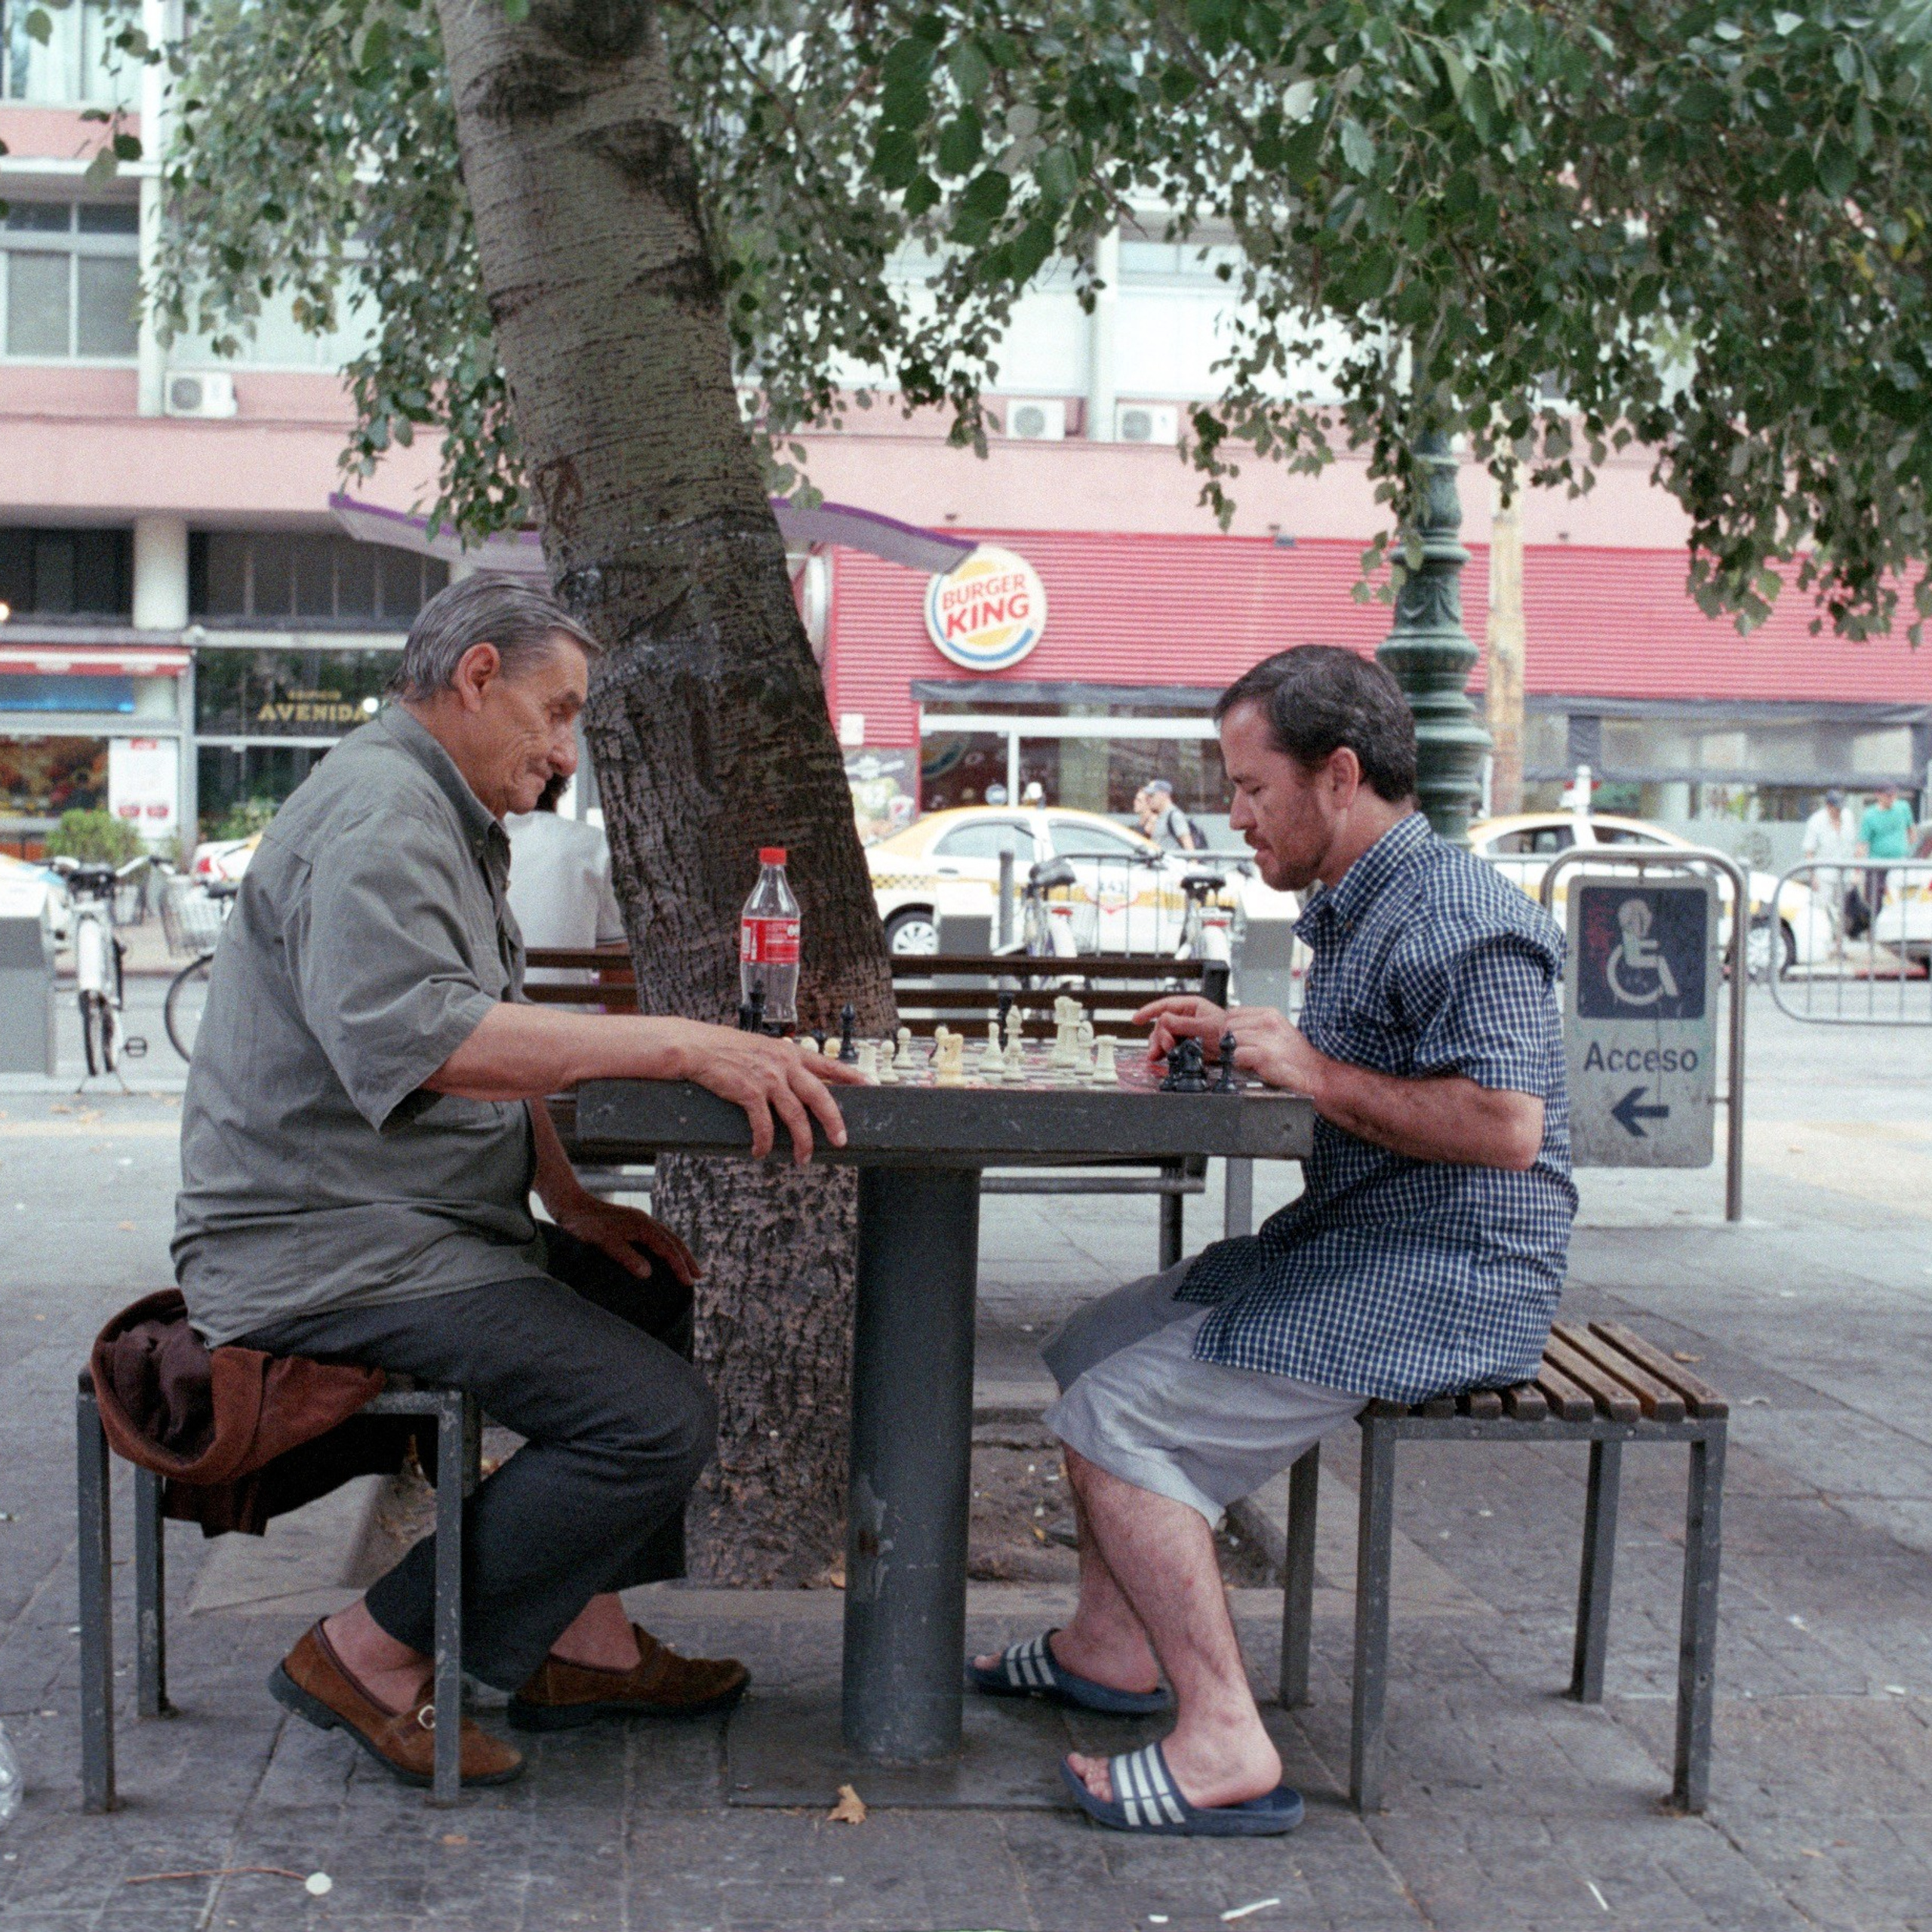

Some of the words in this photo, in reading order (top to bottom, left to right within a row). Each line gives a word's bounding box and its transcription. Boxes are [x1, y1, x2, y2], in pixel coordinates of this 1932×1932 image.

[943, 574, 1026, 611] BURGER
[946, 593, 1029, 639] KING
[257, 703, 371, 721] AVENIDA
[1583, 1041, 1699, 1072] Acceso
